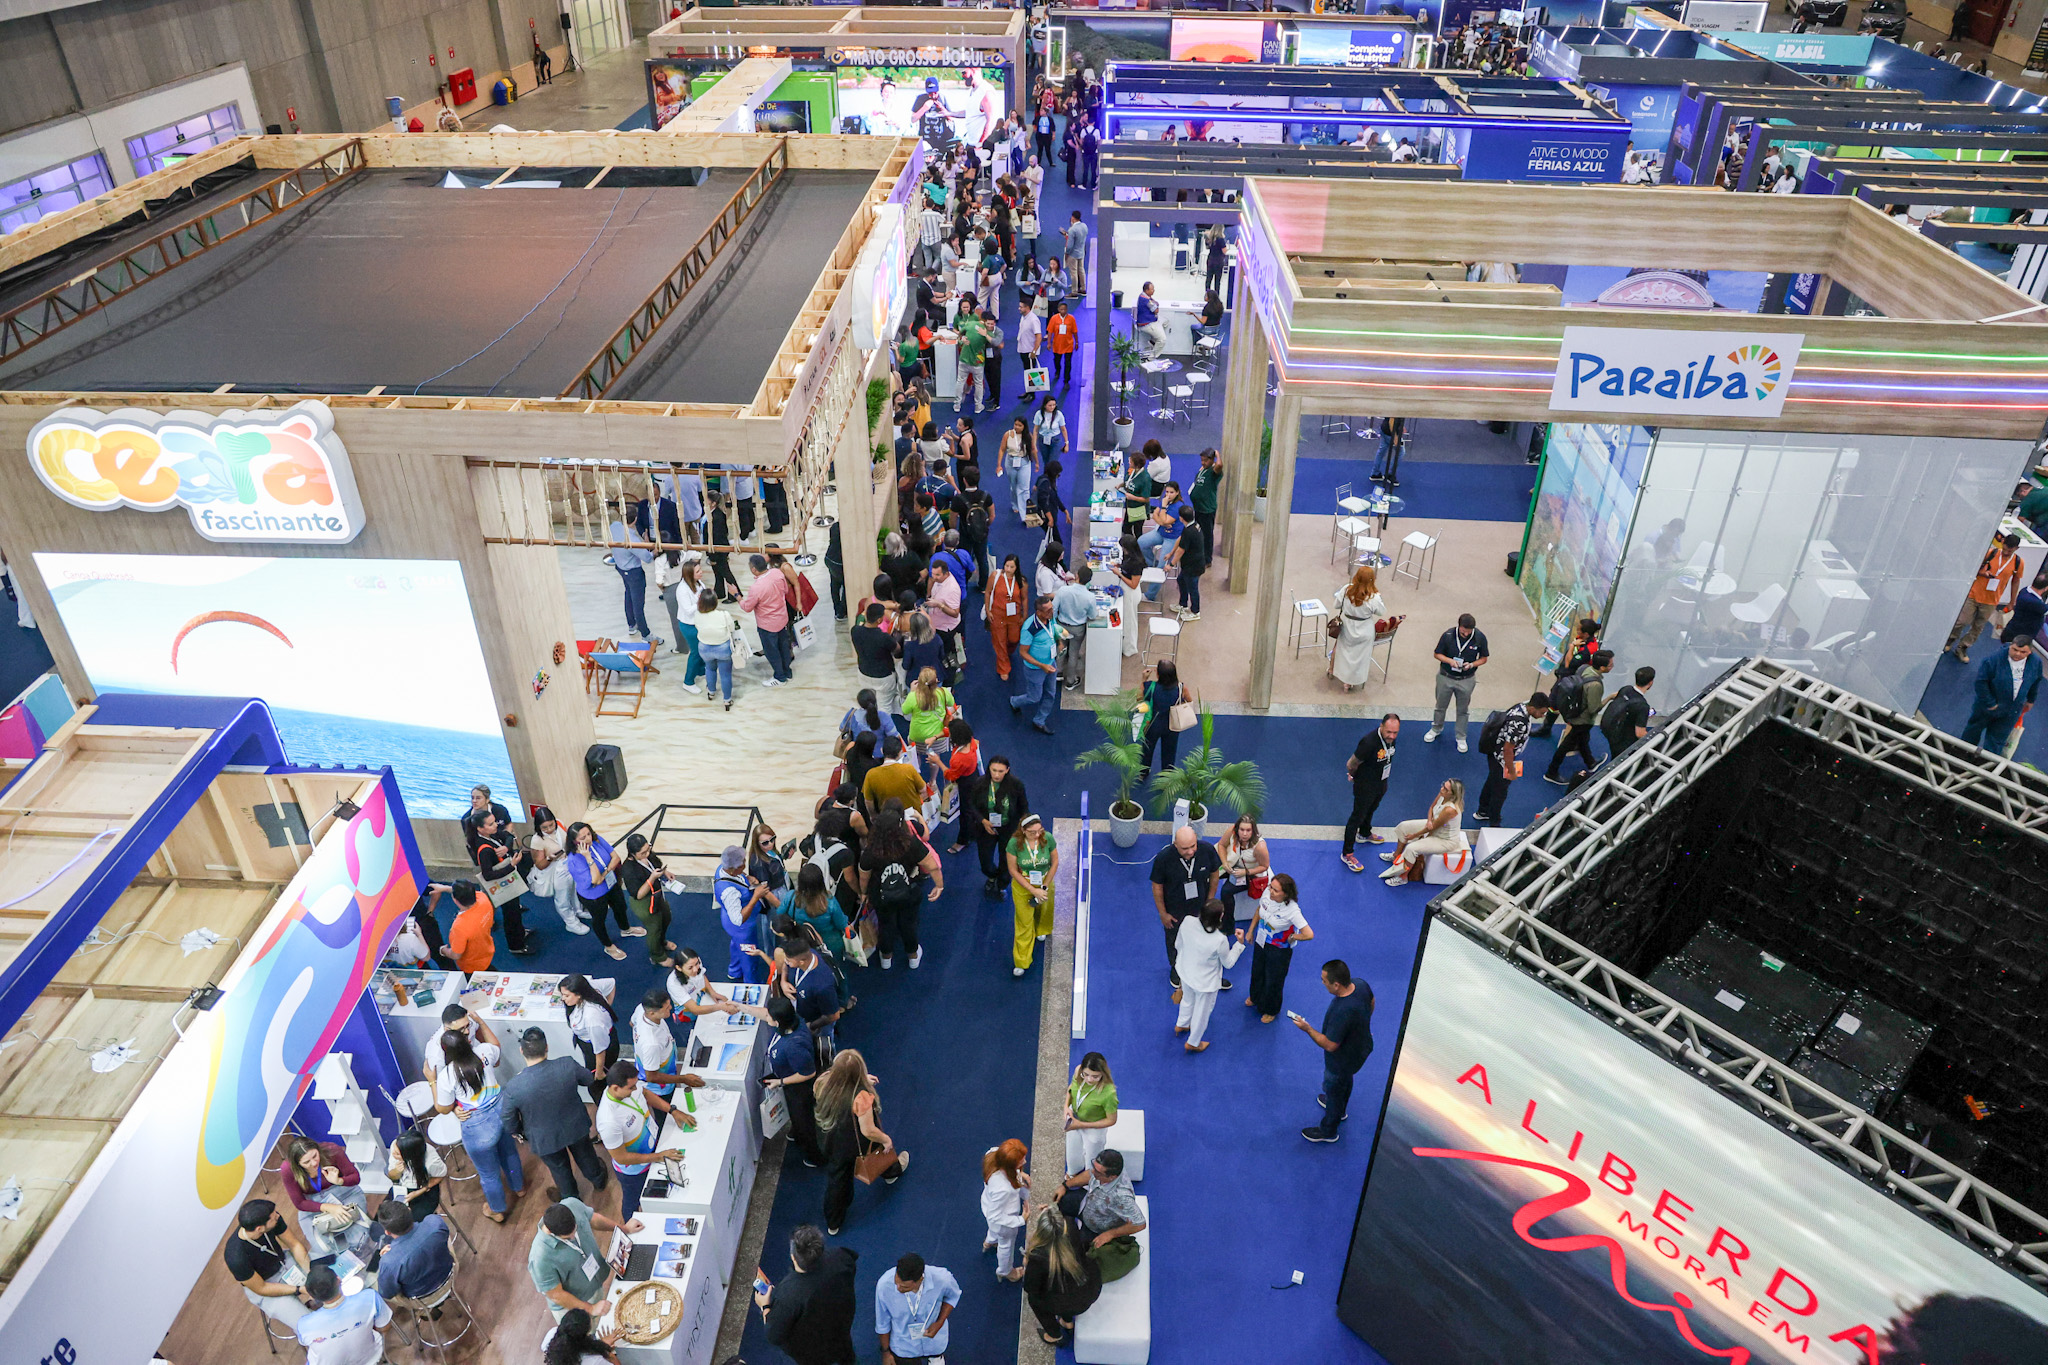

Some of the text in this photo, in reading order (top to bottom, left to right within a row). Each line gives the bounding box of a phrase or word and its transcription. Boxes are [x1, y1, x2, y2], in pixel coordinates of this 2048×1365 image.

[1349, 44, 1395, 54] Complexo
[1775, 44, 1825, 59] BRASIL
[851, 49, 986, 66] MATO GROSSO DO SUL
[1529, 147, 1609, 159] ATIVE O MODO
[1528, 158, 1605, 172] FÉRIAS AZUL
[201, 509, 342, 532] fascinante
[1456, 1063, 1929, 1365] A LIBERDA
[1617, 1210, 1810, 1353] MORA EM
